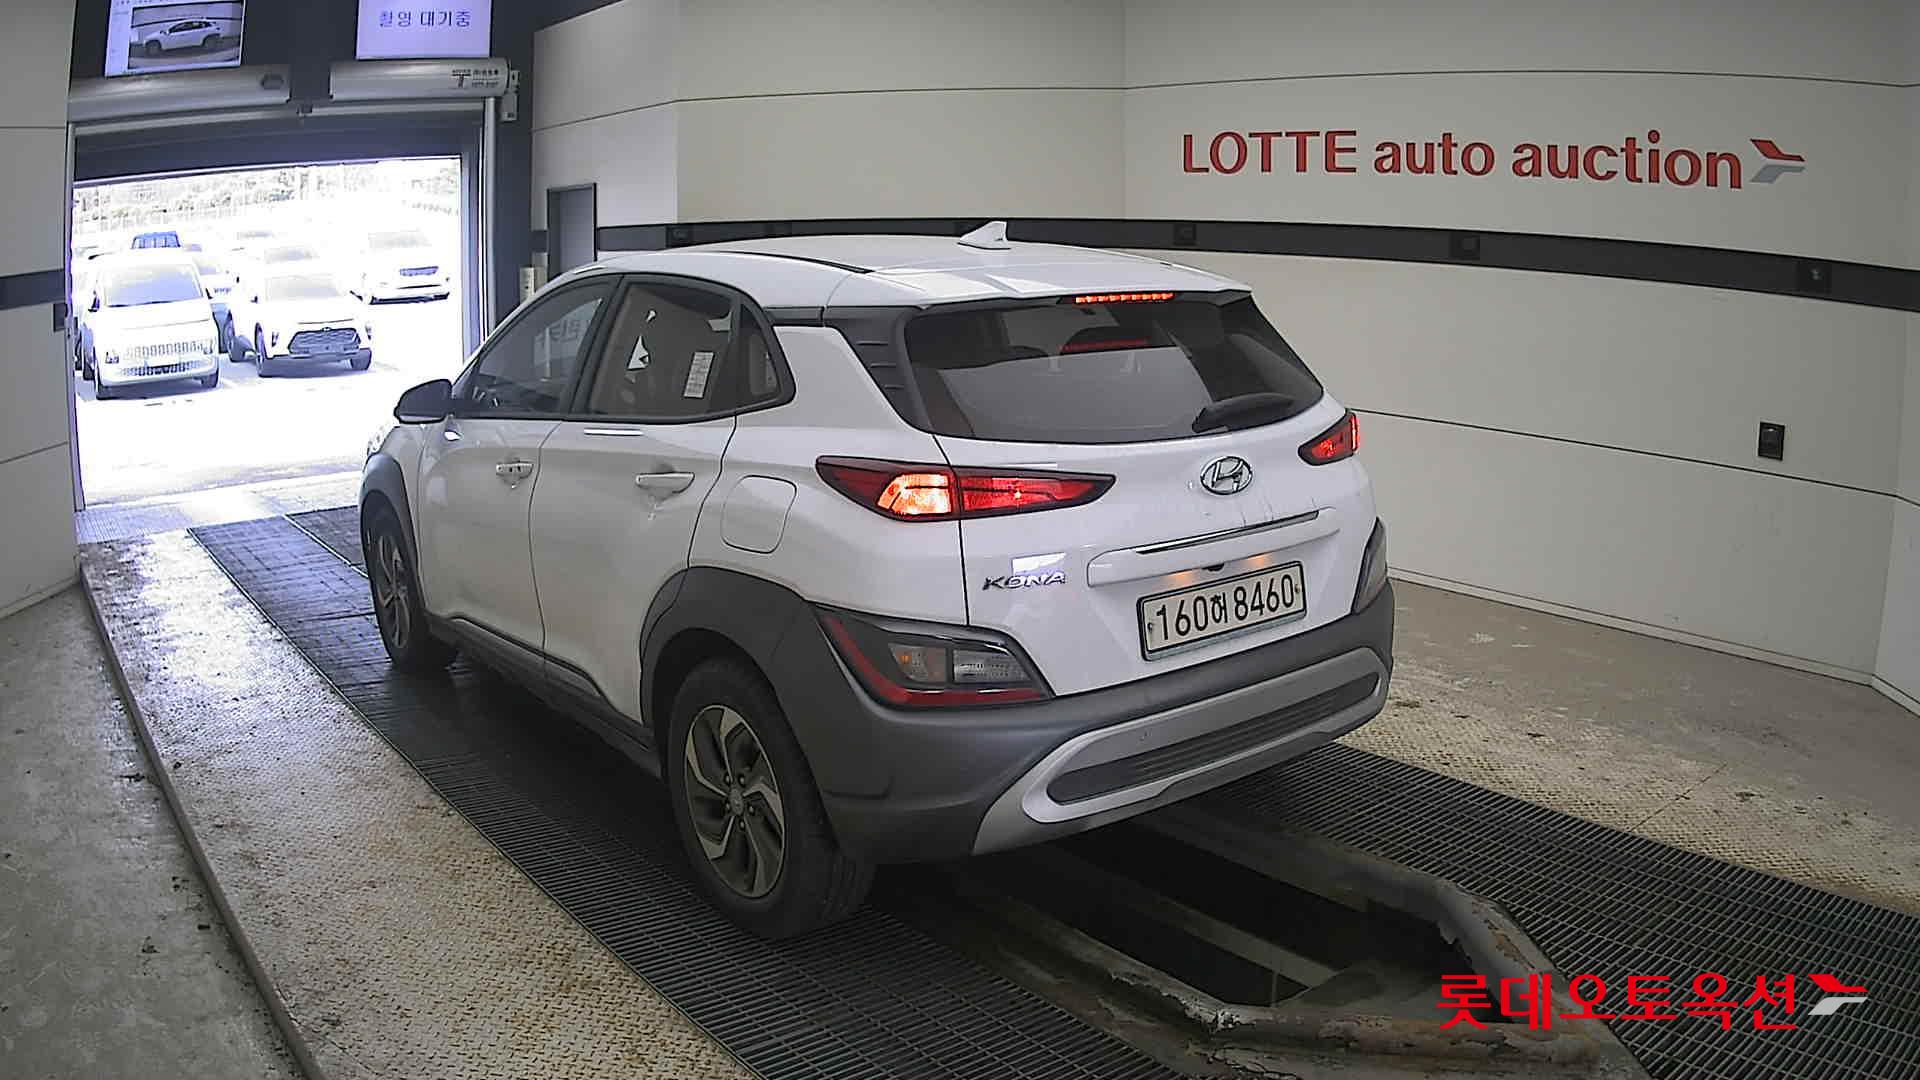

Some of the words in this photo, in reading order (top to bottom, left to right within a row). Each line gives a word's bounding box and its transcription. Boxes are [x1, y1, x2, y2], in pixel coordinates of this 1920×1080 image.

[420, 10, 471, 27] 대기중
[1183, 130, 1357, 174] LOTTE
[1374, 132, 1495, 176] auto
[1512, 129, 1742, 189] auction
[982, 571, 1066, 590] KONA
